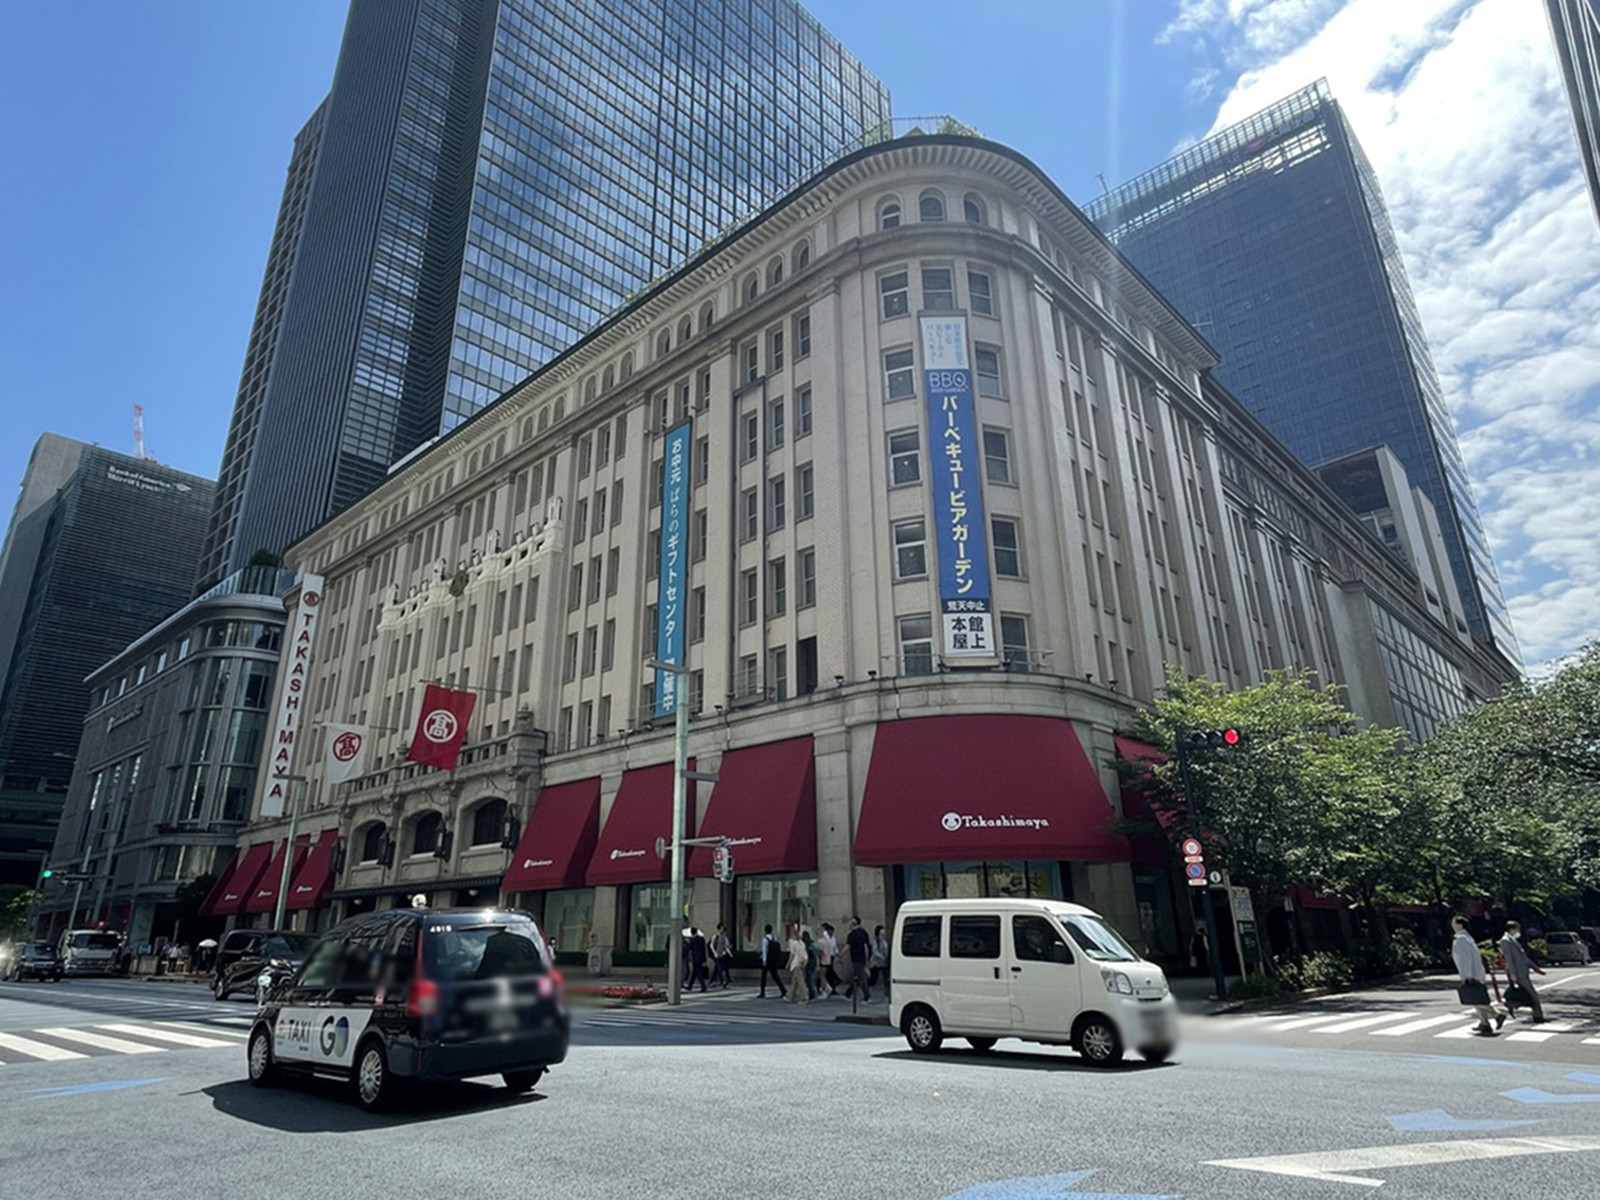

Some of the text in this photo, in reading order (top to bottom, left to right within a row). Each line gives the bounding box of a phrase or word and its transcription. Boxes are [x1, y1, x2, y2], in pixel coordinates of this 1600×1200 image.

[929, 371, 969, 389] BBQ
[942, 395, 973, 595] バーベキュービアガーデン
[951, 616, 984, 632] 本館
[953, 633, 986, 649] 屋上
[269, 613, 314, 798] TAKASHIMAYA
[961, 815, 1049, 830] Takashimaya
[287, 1019, 312, 1043] TAXI
[320, 1015, 349, 1058] GO
